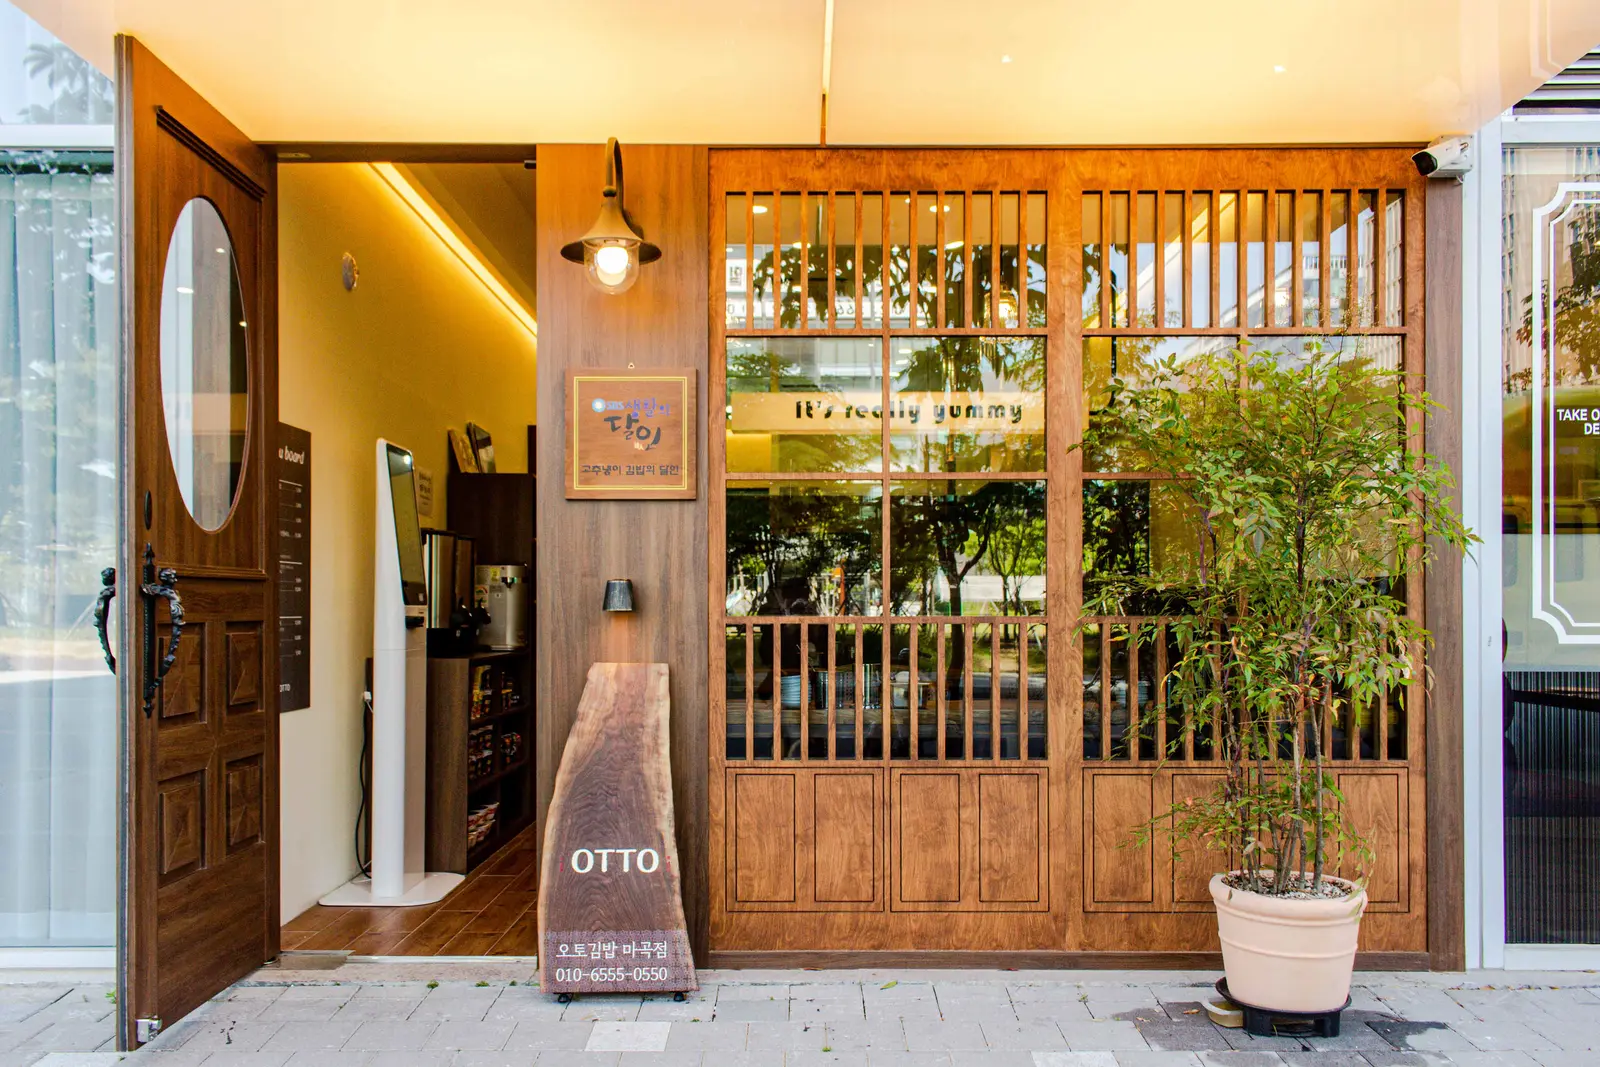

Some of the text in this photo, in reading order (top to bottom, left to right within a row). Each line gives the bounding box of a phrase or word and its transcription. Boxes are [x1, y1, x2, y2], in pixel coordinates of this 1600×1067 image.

[625, 397, 671, 418] 생활의
[795, 400, 1023, 424] It's really yummy
[1556, 408, 1588, 421] TAKE
[604, 414, 661, 451] 달인
[284, 445, 305, 465] board
[581, 465, 680, 476] 고추냉이 김밥의 달인
[571, 848, 659, 873] OTTO
[556, 941, 667, 959] 오토김밥 마곡점
[555, 967, 668, 982] 010-6555-0550
